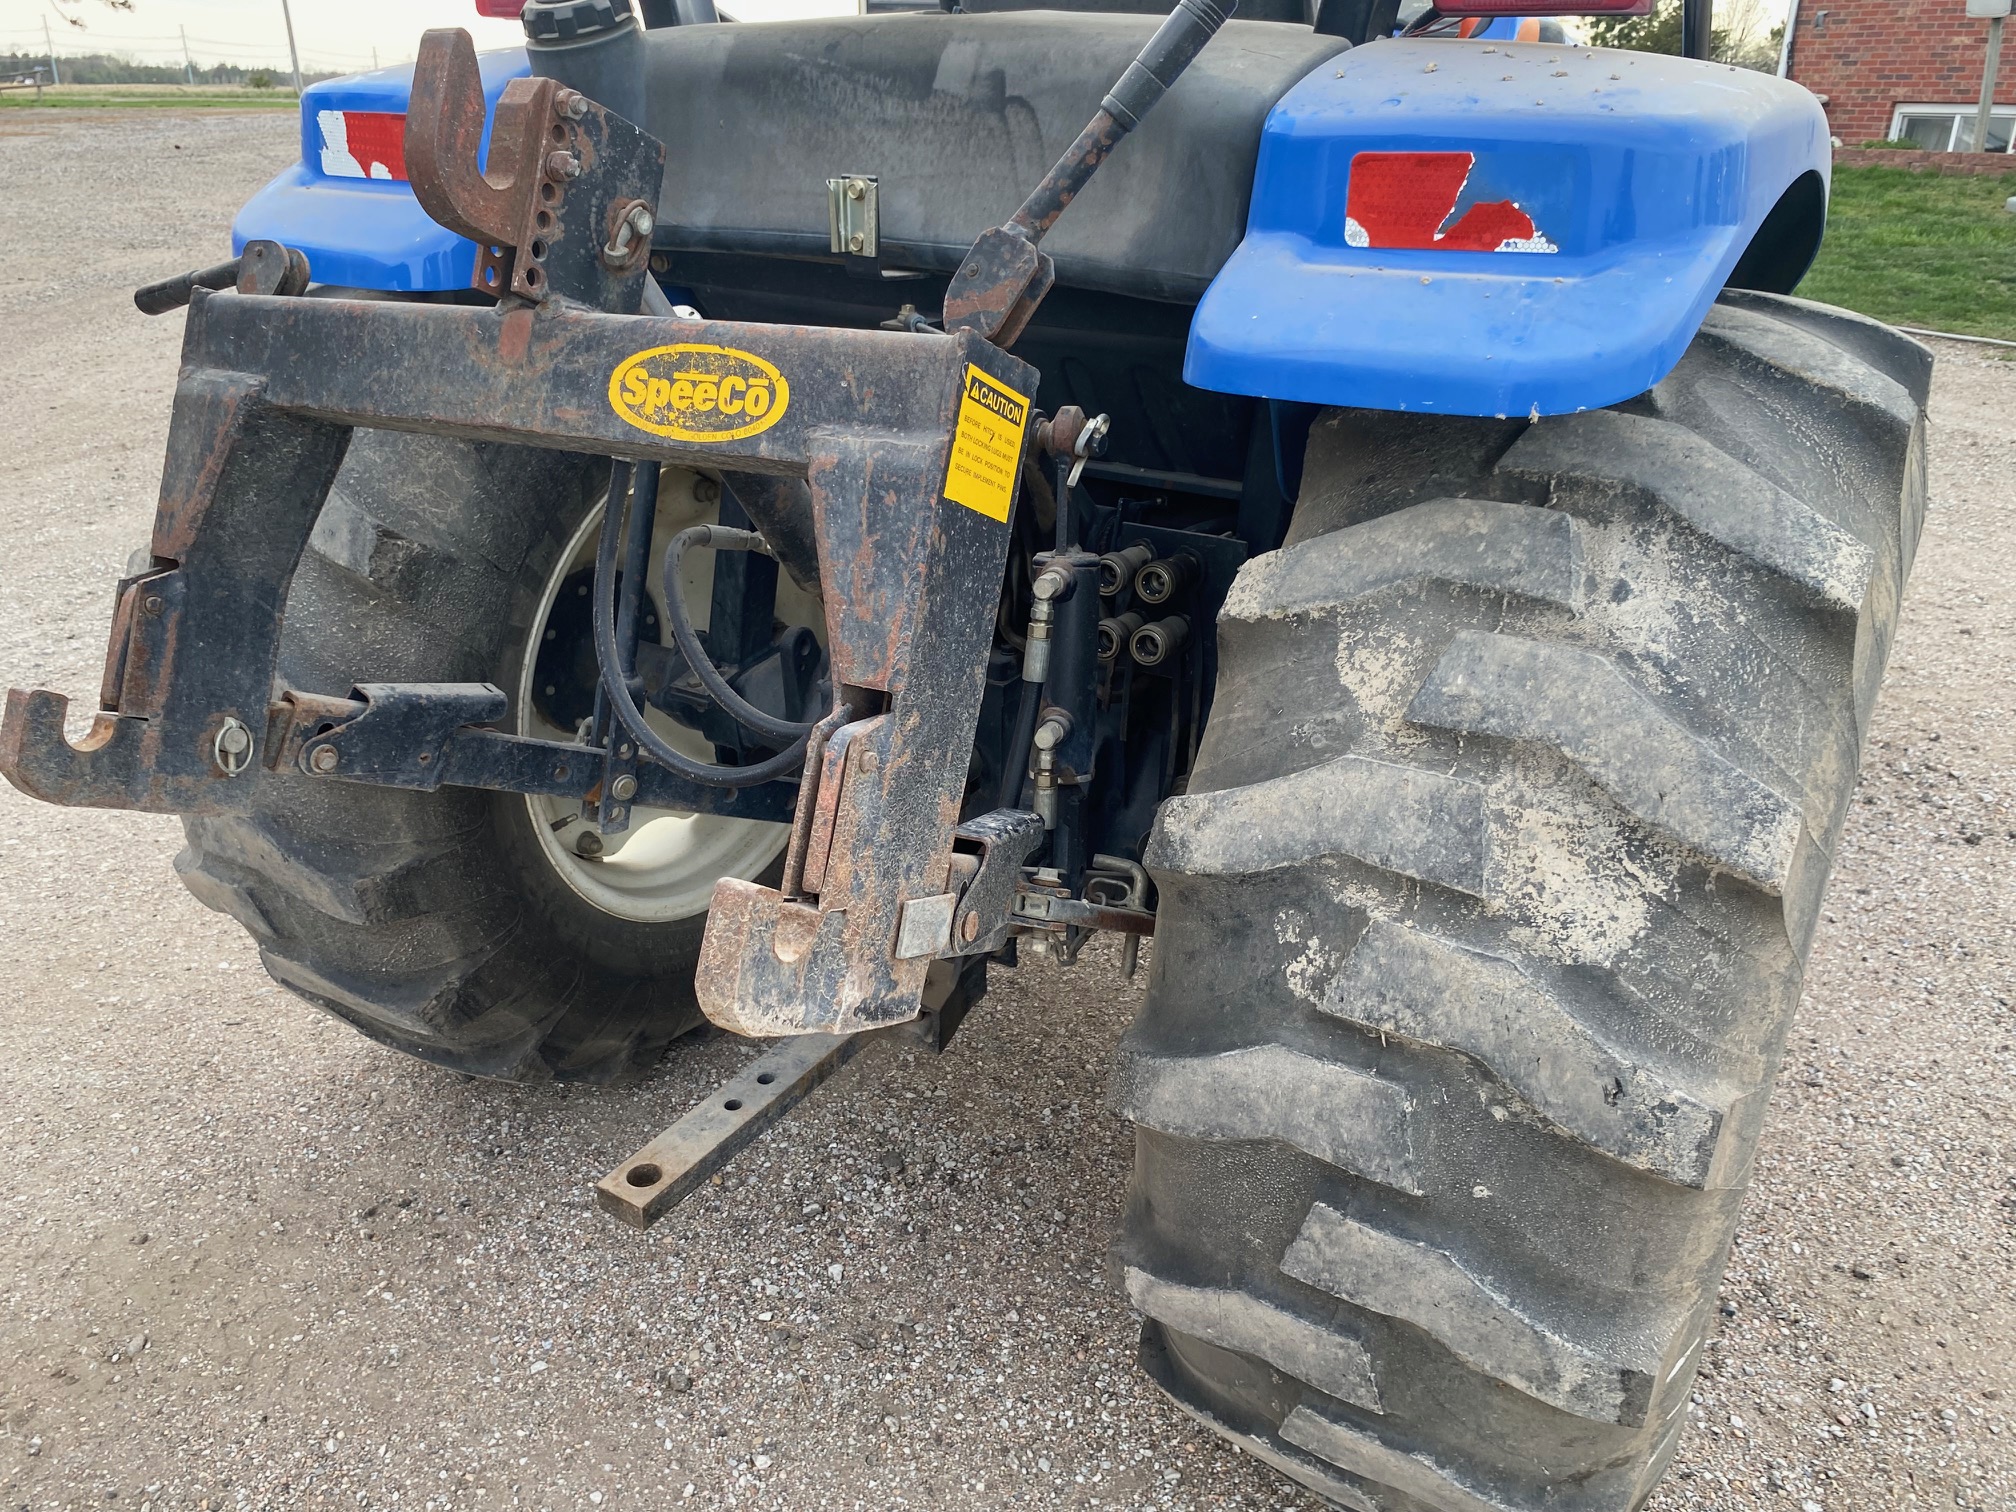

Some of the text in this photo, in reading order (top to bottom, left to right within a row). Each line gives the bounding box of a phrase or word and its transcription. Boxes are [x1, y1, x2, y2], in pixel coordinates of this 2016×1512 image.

[980, 386, 1022, 424] CAUTION
[964, 415, 981, 429] BEFORE
[957, 447, 1011, 479] BE IN LOCK POSITION TO
[961, 431, 1014, 463] BOTH LOCKING LUGS MUST
[954, 463, 972, 476] SECURE
[972, 471, 996, 487] IMPLEMENT
